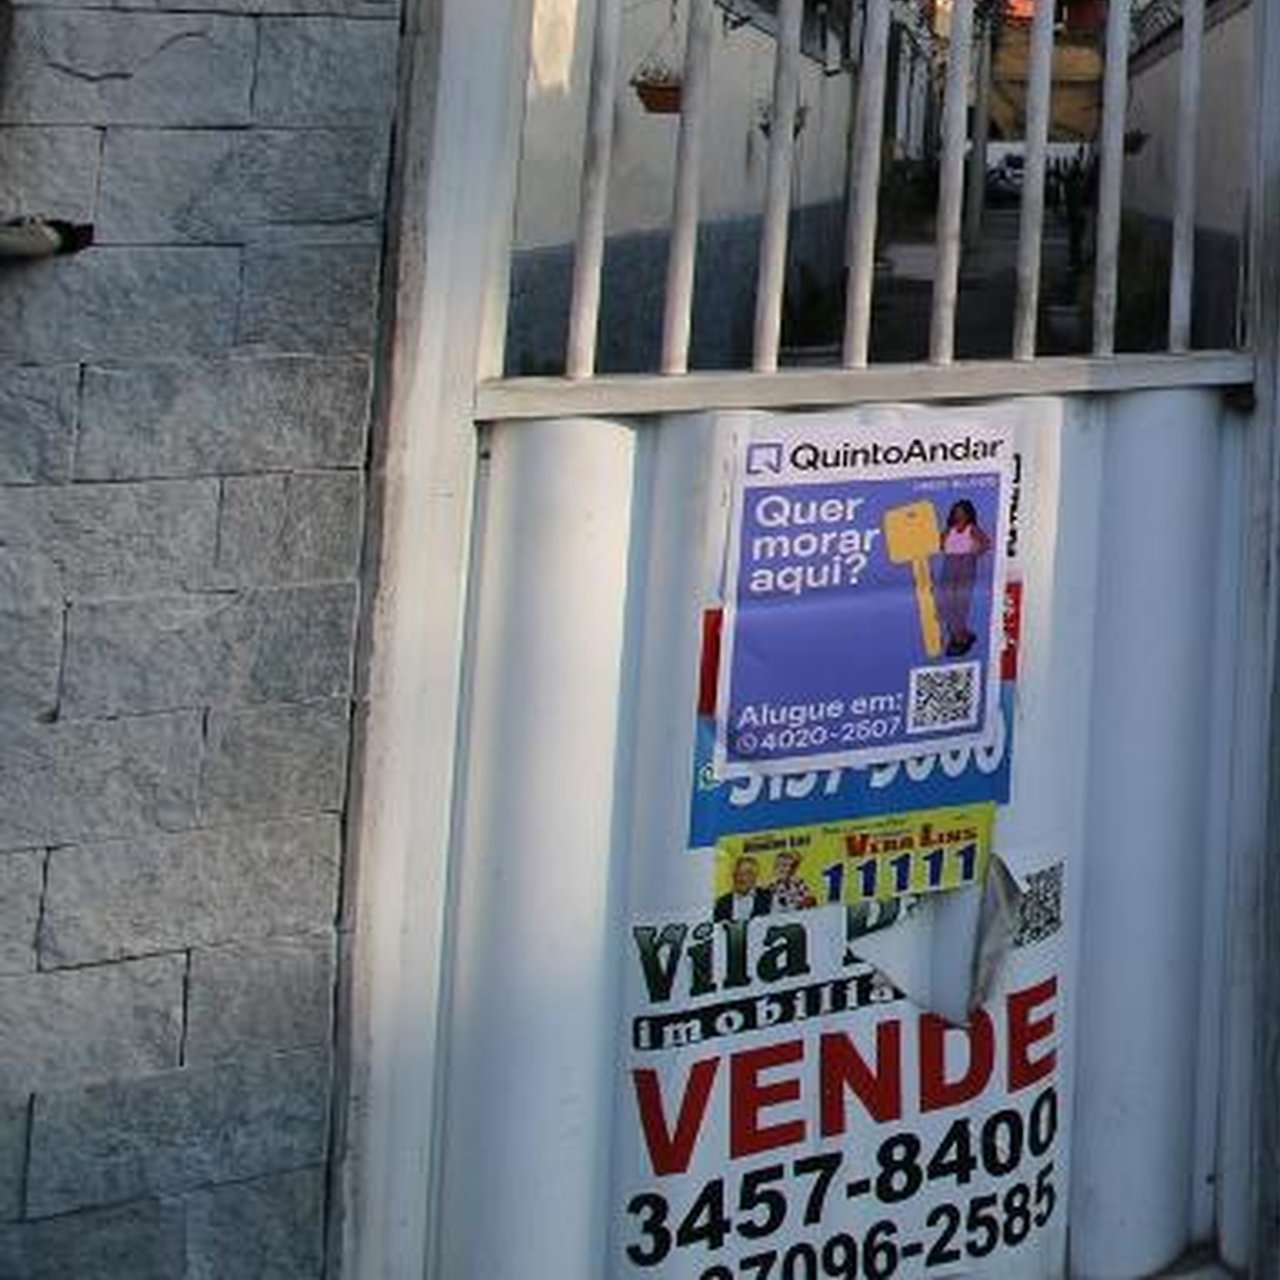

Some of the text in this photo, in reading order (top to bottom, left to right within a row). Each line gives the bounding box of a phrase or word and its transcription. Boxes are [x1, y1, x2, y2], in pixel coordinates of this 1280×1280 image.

[789, 437, 1003, 470] QuintoAndar
[755, 494, 864, 527] Quer
[749, 553, 867, 594] aqui?
[752, 527, 880, 561] morar
[737, 691, 903, 728] Alugue em:
[821, 842, 977, 902] 11111
[633, 917, 810, 1004] Vila
[638, 980, 897, 1049] imobilia
[632, 976, 1058, 1177] VENDE
[625, 1087, 1058, 1267] 3457-8400
[699, 1162, 1055, 1280] 7096-2585
